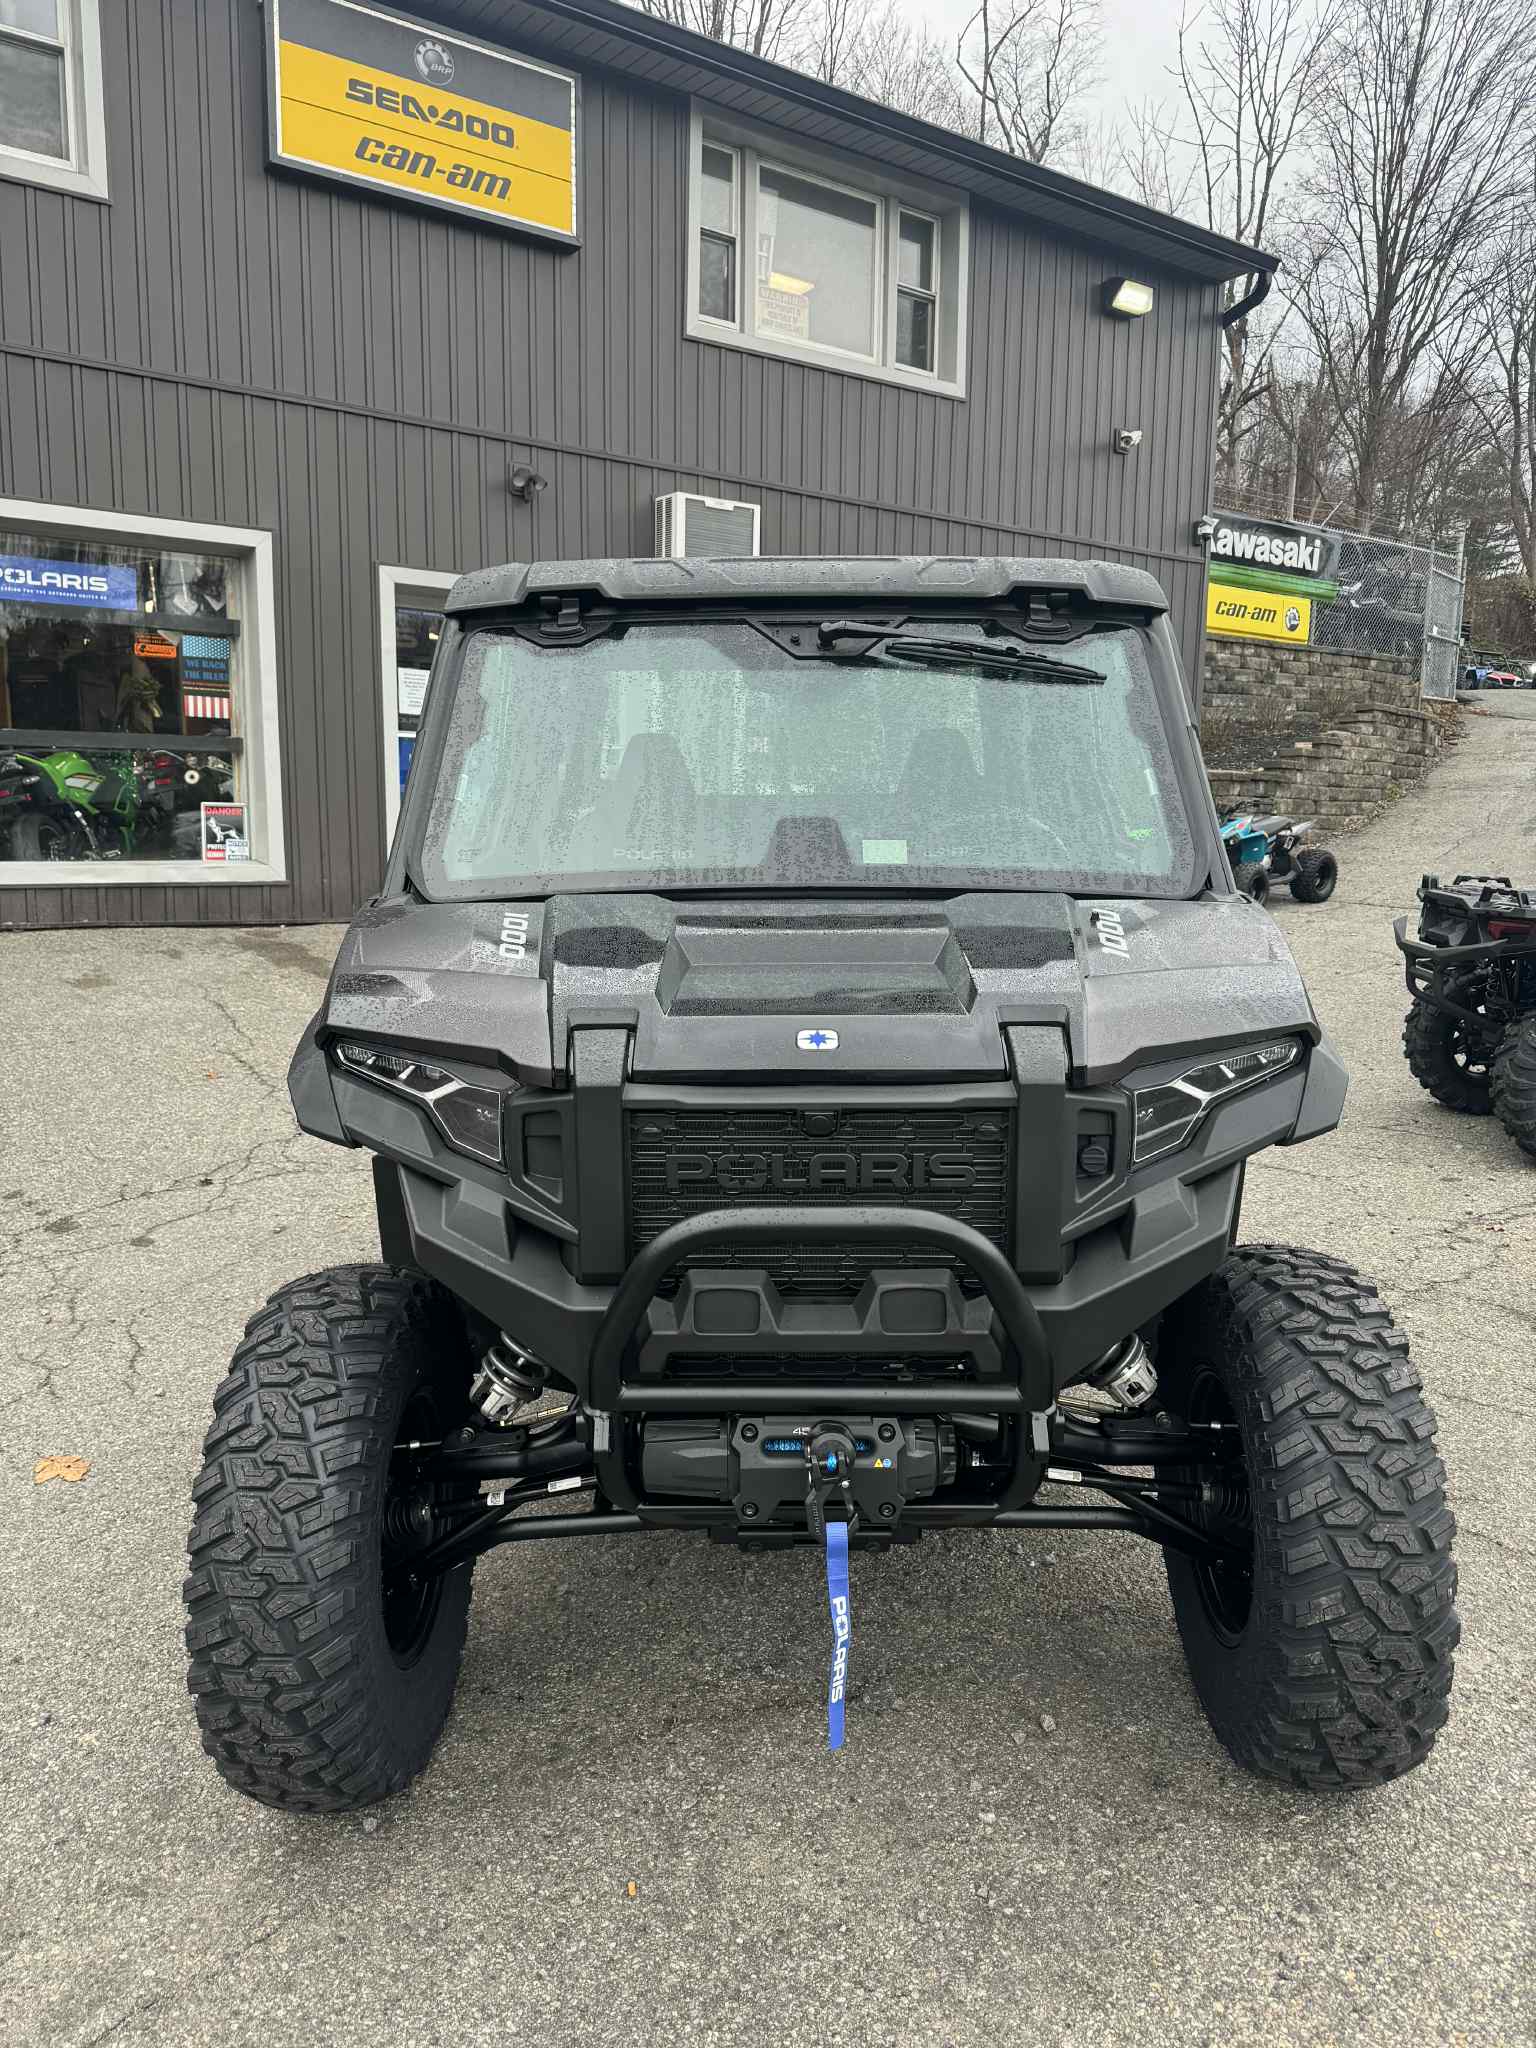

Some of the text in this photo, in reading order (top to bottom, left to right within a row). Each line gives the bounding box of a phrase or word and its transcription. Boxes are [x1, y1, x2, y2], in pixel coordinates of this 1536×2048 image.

[206, 807, 243, 815] DANGER
[499, 912, 529, 960] 1000
[665, 1153, 977, 1192] POLARIS
[831, 1596, 849, 1703] POLARIS
